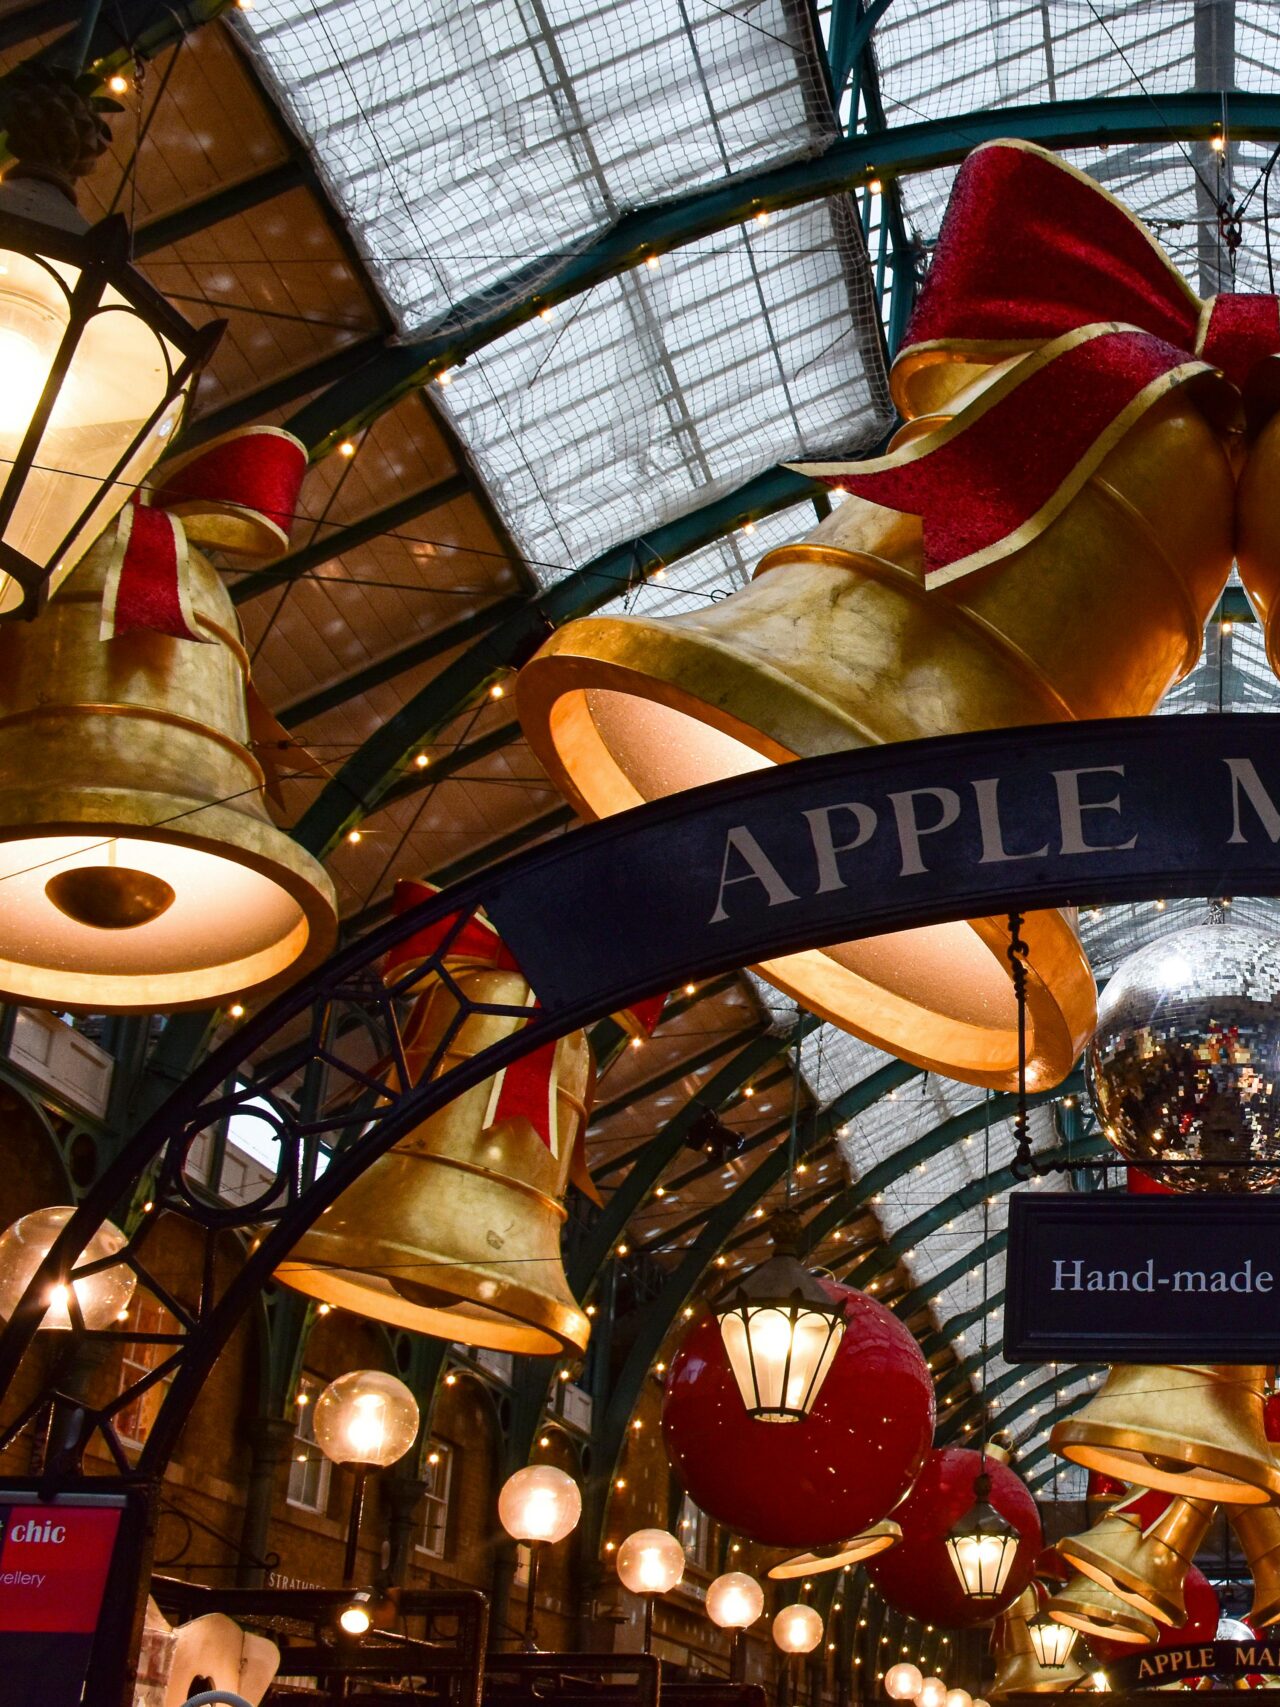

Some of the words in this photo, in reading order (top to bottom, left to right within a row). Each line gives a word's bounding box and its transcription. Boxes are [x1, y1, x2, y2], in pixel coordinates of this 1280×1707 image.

[708, 764, 1138, 924] APPLE
[1051, 1259, 1274, 1294] Hand-made
[11, 1519, 66, 1544] chic
[1138, 1648, 1216, 1679] APPLE
